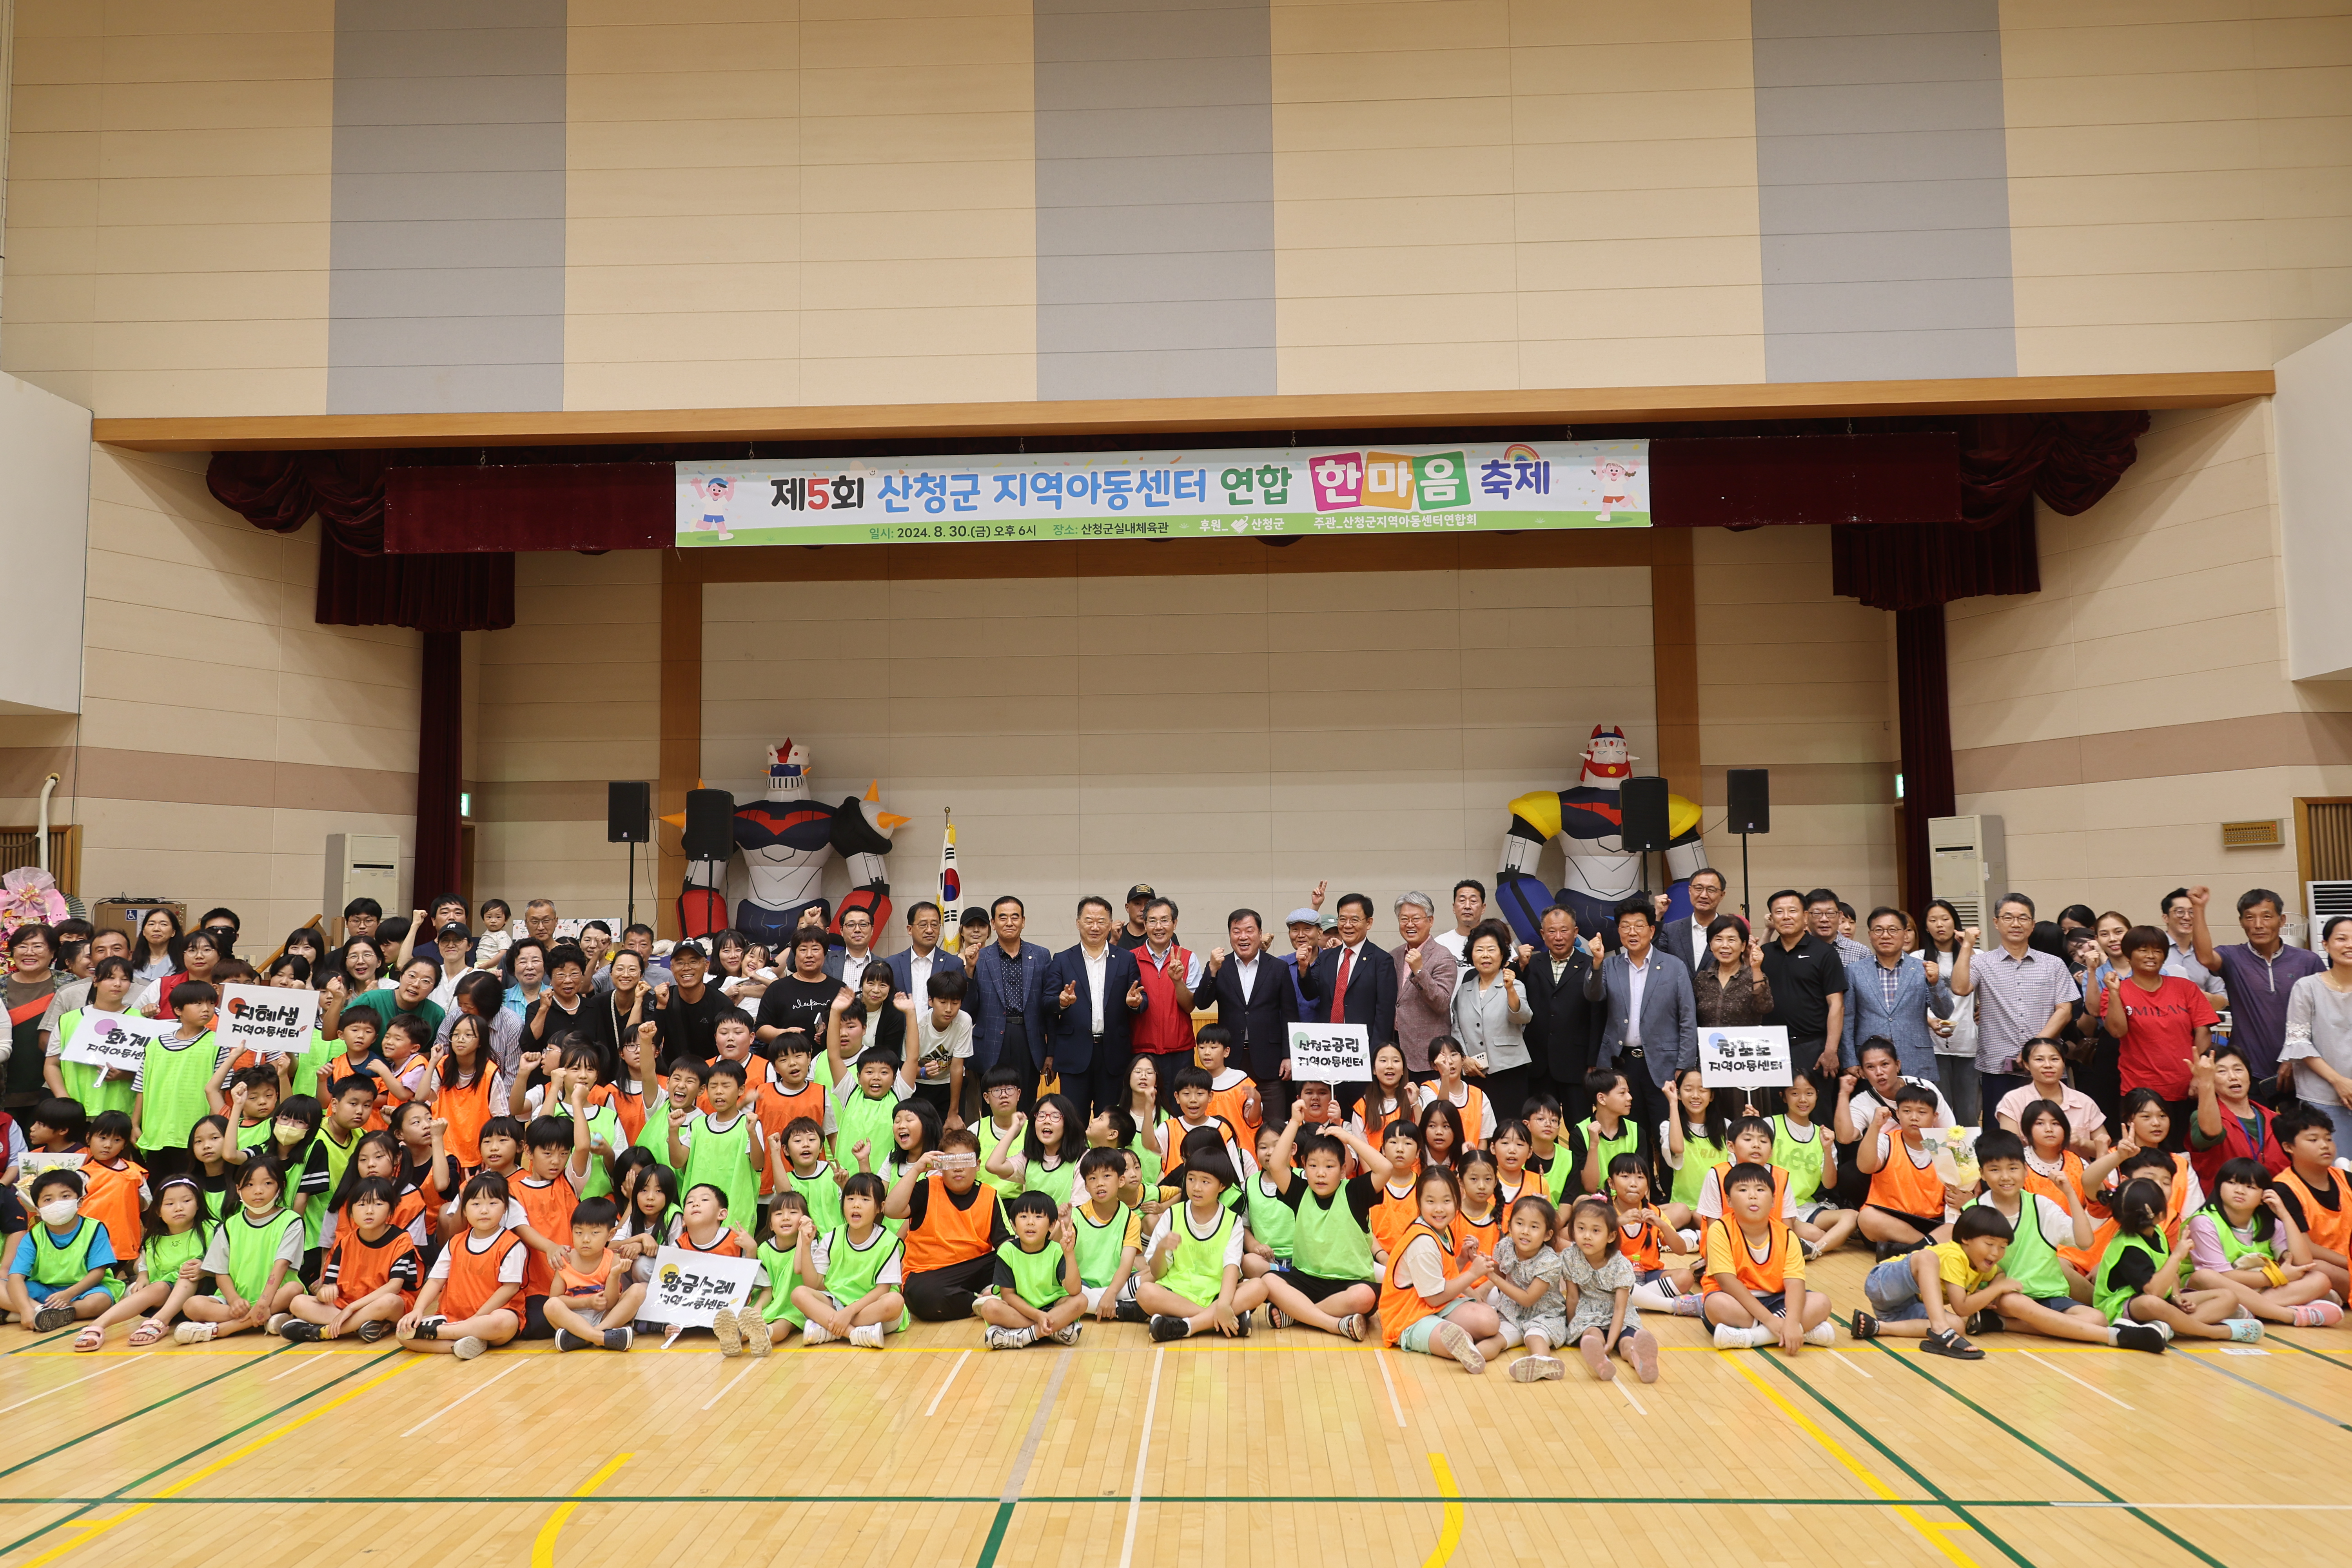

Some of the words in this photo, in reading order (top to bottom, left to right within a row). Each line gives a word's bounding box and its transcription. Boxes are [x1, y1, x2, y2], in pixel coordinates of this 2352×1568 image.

[771, 475, 864, 511] 제5회
[877, 472, 980, 513] 산청군
[993, 469, 1206, 510] 지역아동센터
[1220, 464, 1292, 506] 연합
[1315, 458, 1459, 503] 한마음
[1481, 459, 1550, 500] 축제
[869, 528, 894, 539] 일시:
[897, 528, 931, 537] 2024.
[934, 526, 946, 537] 8.
[949, 525, 991, 538] 30.(금)
[994, 526, 1015, 536] 오후
[1018, 524, 1036, 535] 6시
[1053, 524, 1078, 535] 장소:
[1081, 522, 1169, 535] 산청군실내체육관
[1200, 519, 1229, 532] 후원_
[1251, 518, 1285, 531] 산청군
[235, 1004, 299, 1025] 지혜샘
[232, 1024, 299, 1037] 지역아동센터
[86, 1043, 146, 1060] 지역아동센
[1298, 1056, 1363, 1068] 지역아동센터
[1709, 1060, 1783, 1072] 지역아동센터
[1777, 1139, 1820, 1175] Lee
[661, 1271, 736, 1295] 황금수레
